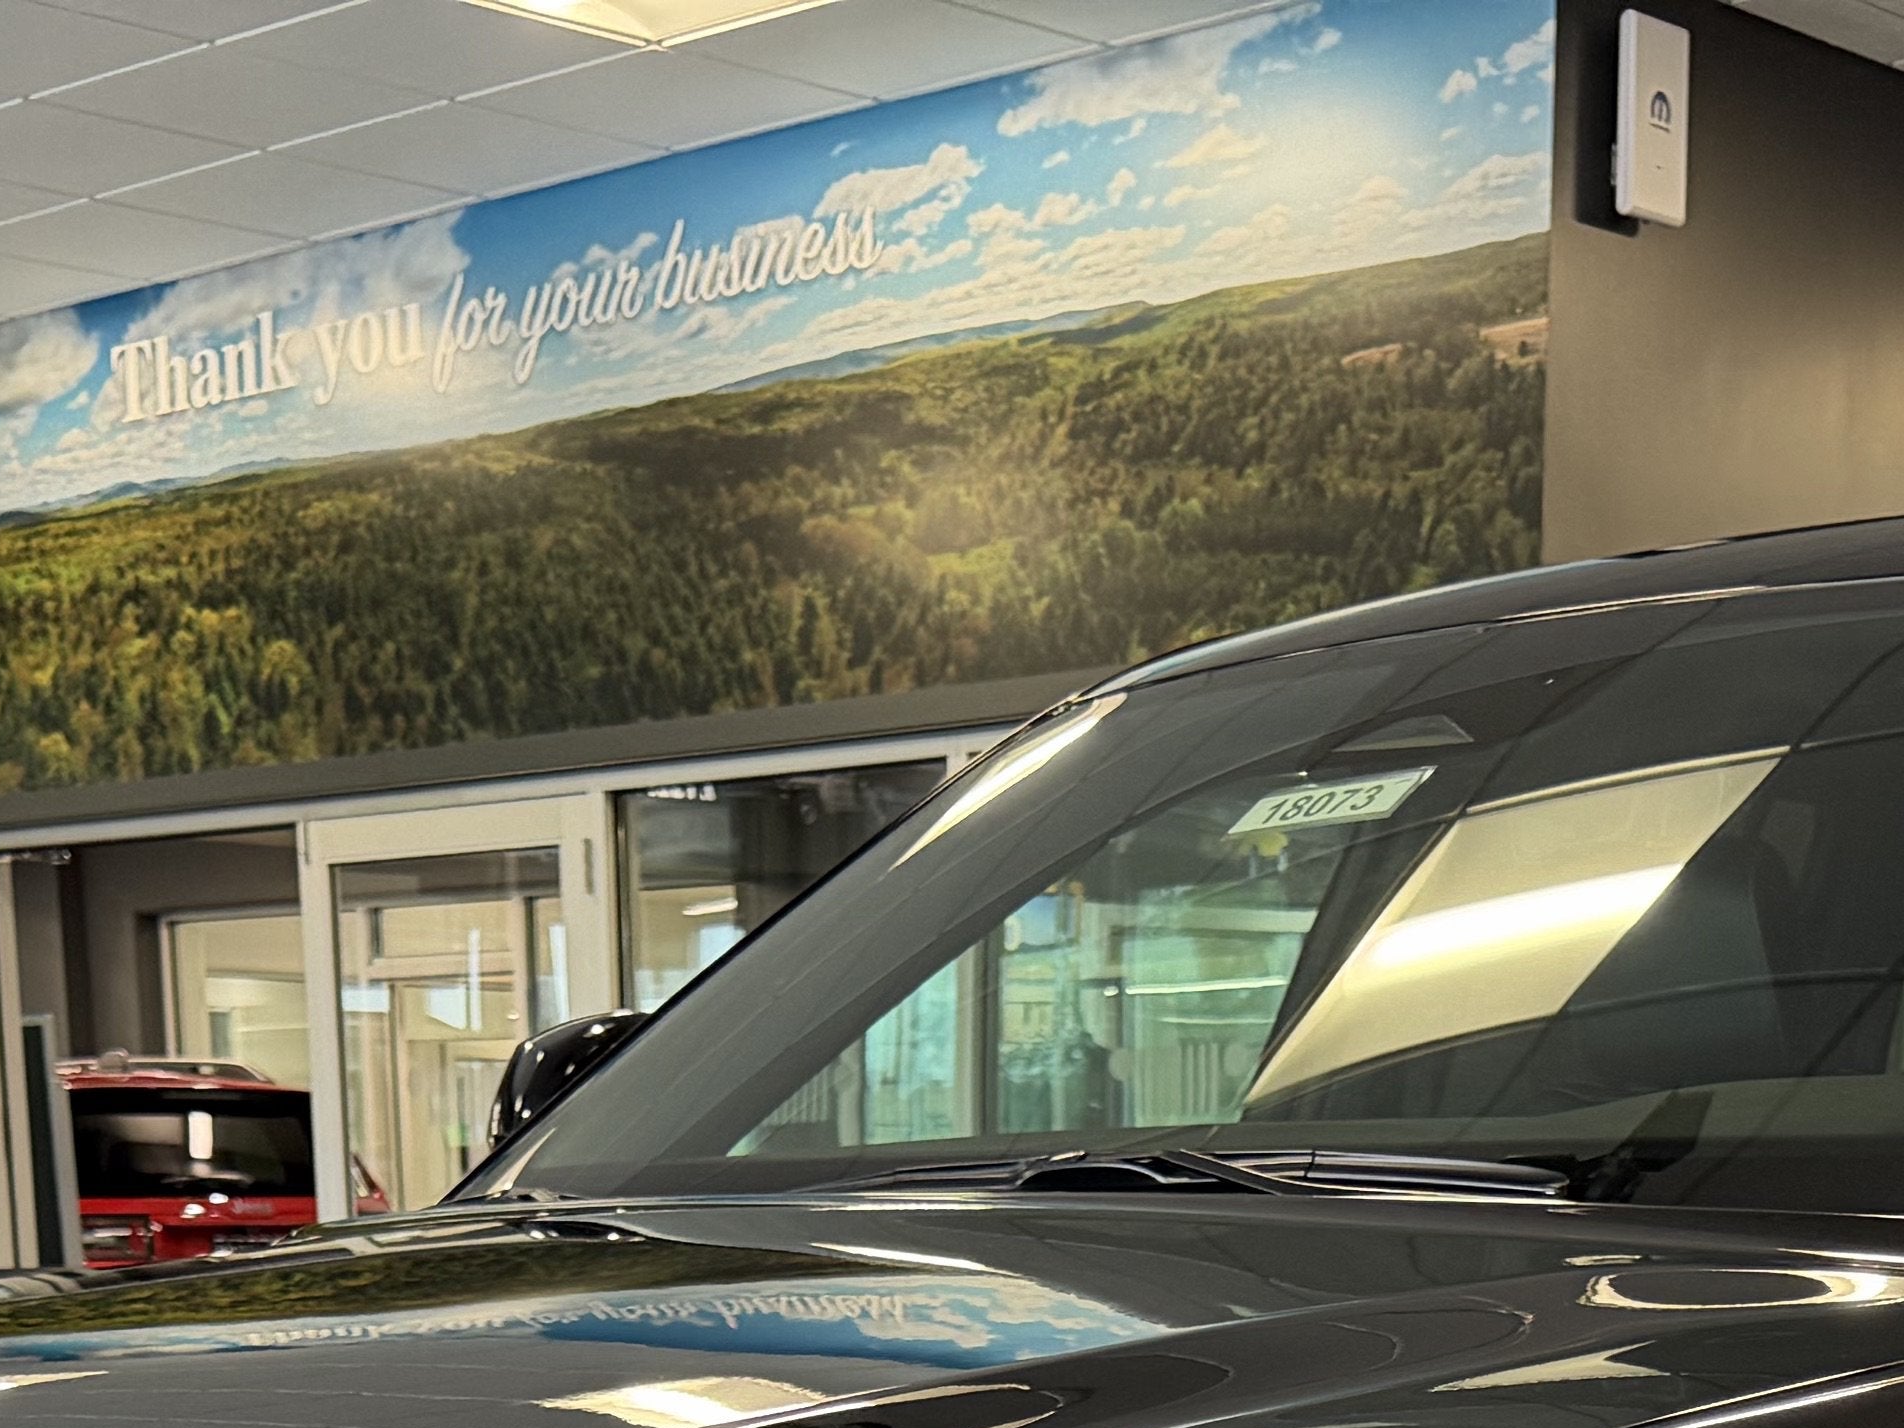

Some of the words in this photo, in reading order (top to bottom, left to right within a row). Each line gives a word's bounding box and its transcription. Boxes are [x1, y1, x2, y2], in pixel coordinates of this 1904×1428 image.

[110, 309, 299, 424] Thank
[310, 301, 424, 405] you
[429, 271, 514, 392] for
[515, 267, 647, 385] your
[652, 205, 885, 310] business
[1262, 784, 1385, 825] 18073
